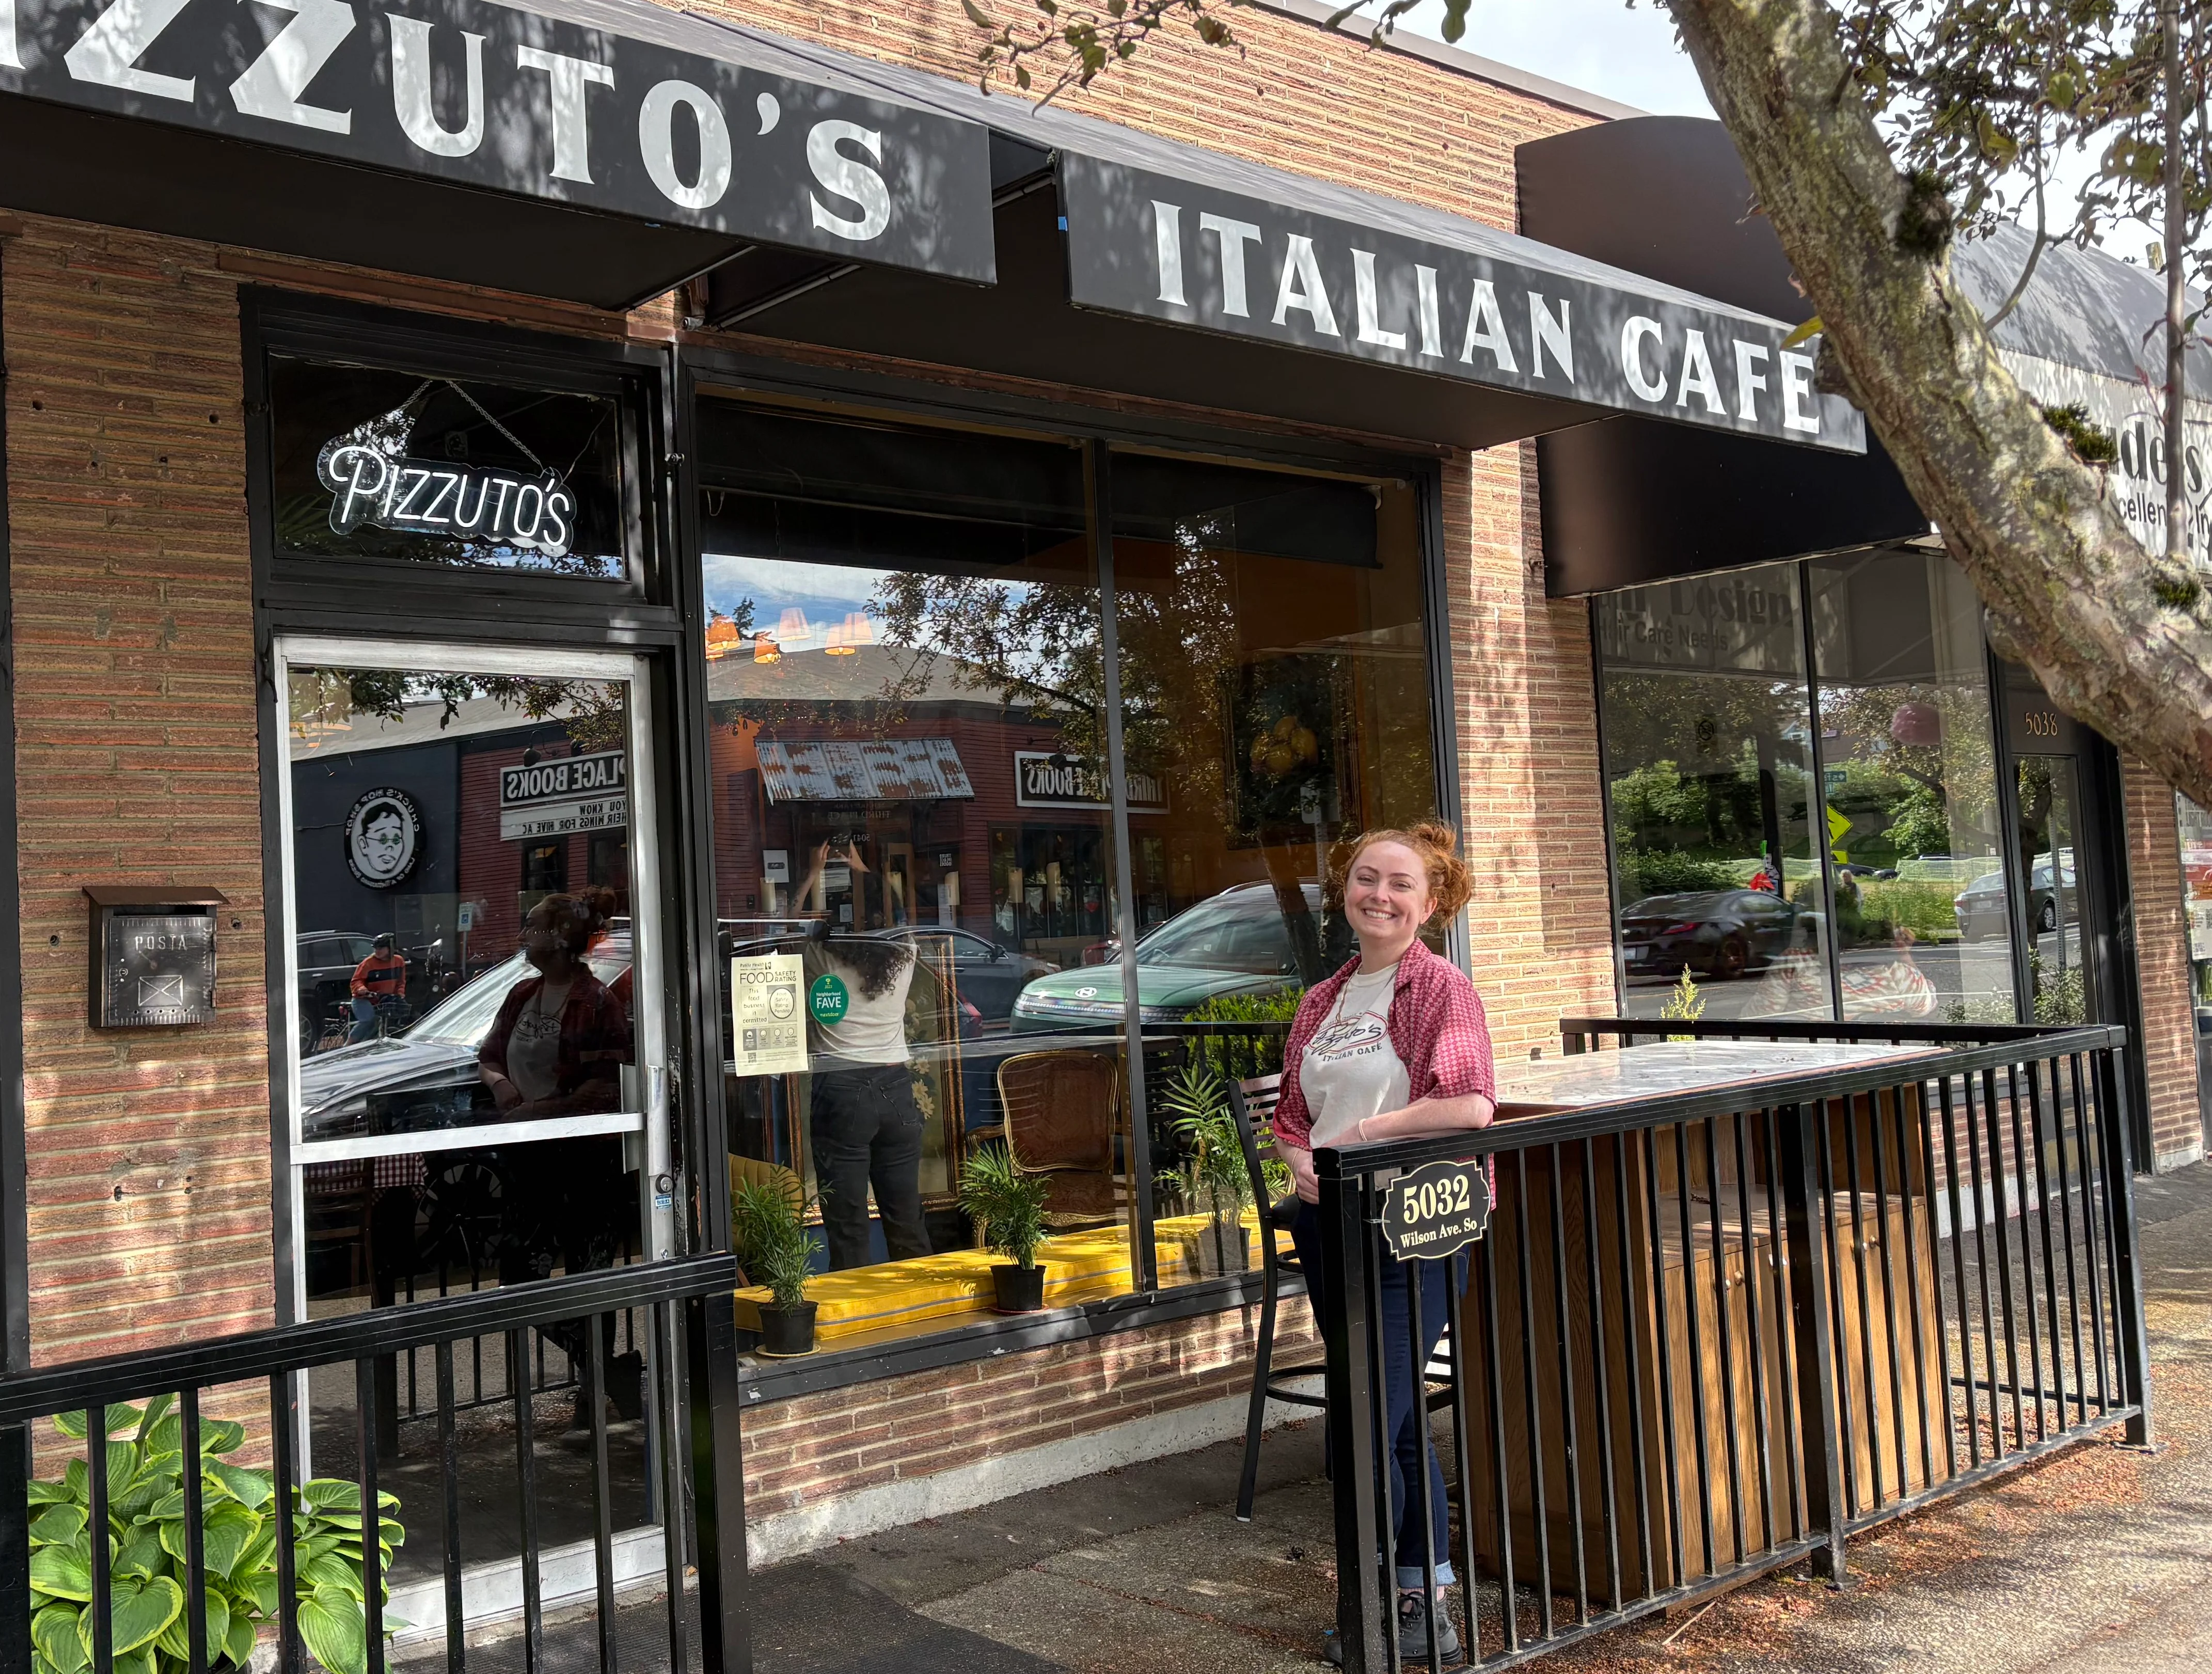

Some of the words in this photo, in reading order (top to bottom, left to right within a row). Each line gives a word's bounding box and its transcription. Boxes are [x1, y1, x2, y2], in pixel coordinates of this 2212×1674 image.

[1150, 199, 1575, 384] ITALIAN
[328, 445, 570, 547] PIZZUTO'S
[2025, 712, 2058, 736] 5038
[135, 935, 187, 951] POSTA
[740, 972, 773, 984] FOOD
[816, 997, 842, 1008] FAVE
[1403, 1175, 1470, 1224] 5032
[1400, 1228, 1437, 1248] Wilson
[1439, 1224, 1462, 1239] Ave.
[1463, 1217, 1477, 1232] So
